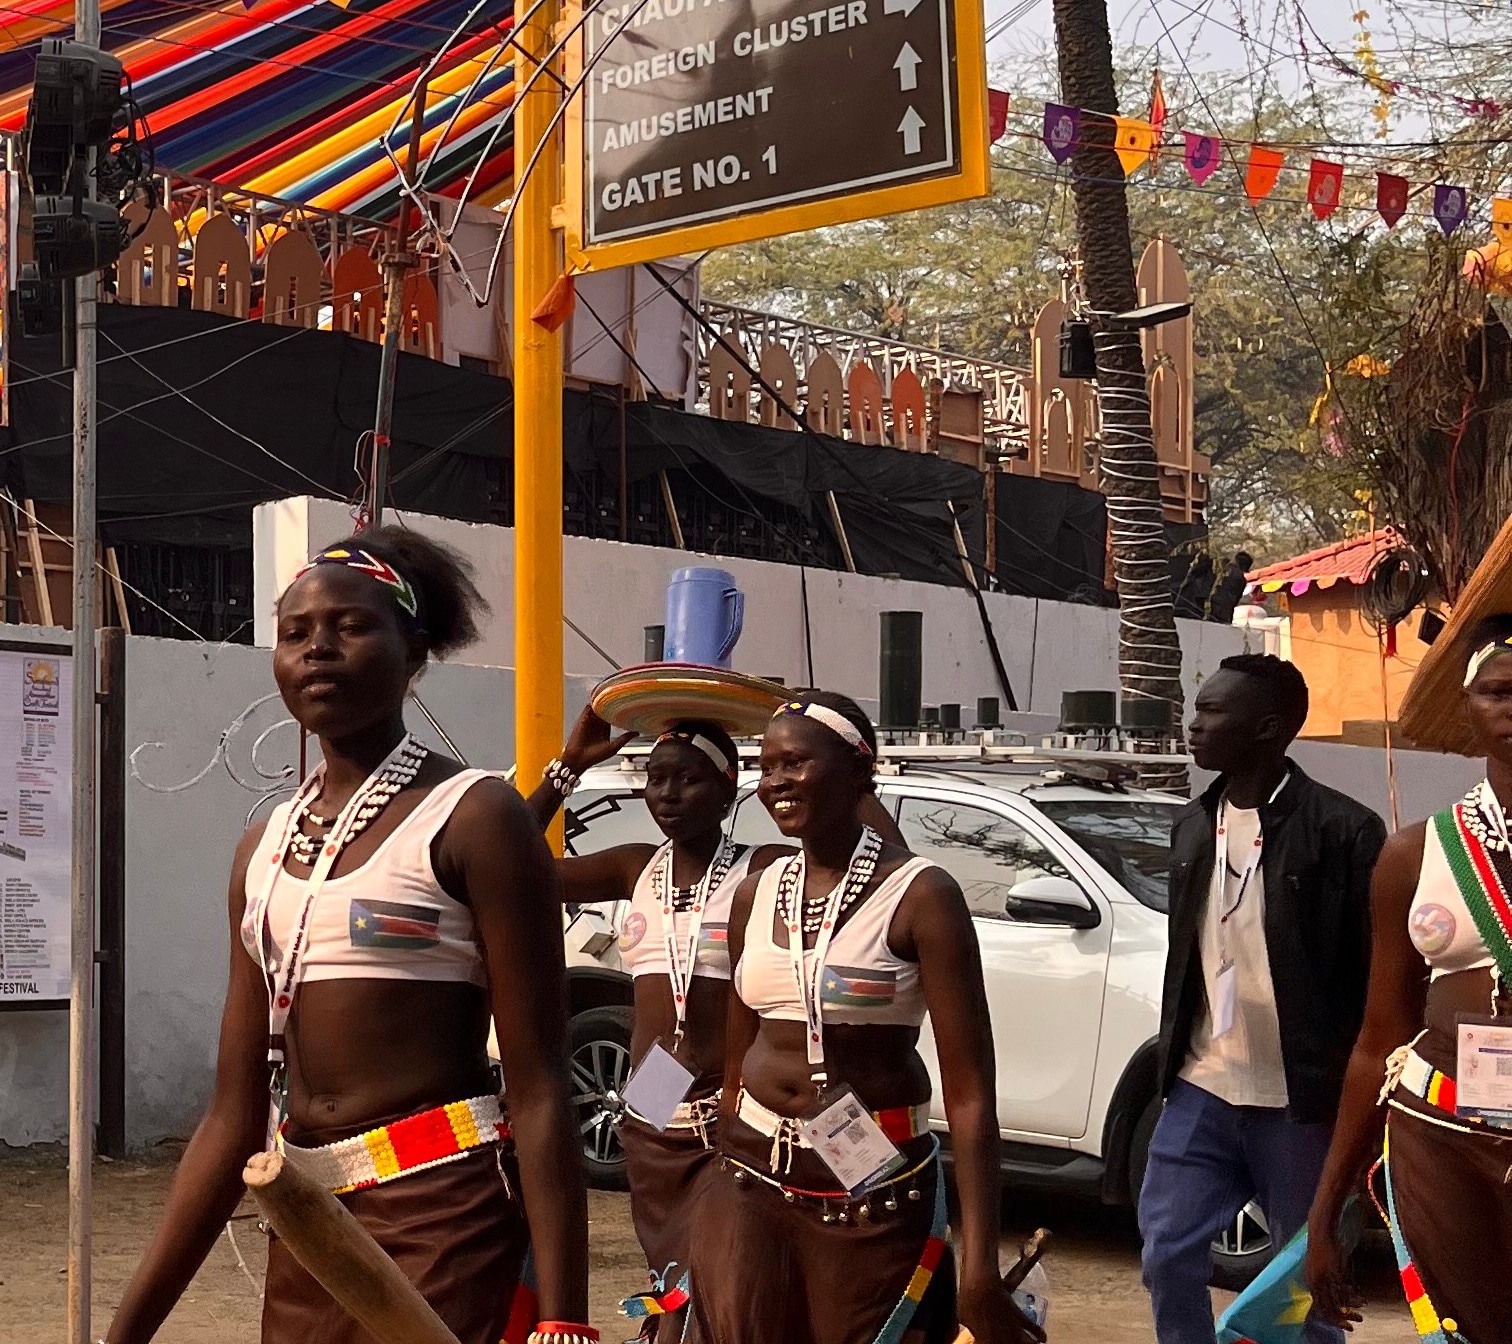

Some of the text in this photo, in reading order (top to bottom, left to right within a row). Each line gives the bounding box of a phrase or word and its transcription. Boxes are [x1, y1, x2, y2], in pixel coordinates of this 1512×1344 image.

[601, 0, 868, 95] FOREIGN CLUSTER
[602, 86, 774, 153] AMUSEMENT
[601, 144, 777, 211] GATE NO. 1
